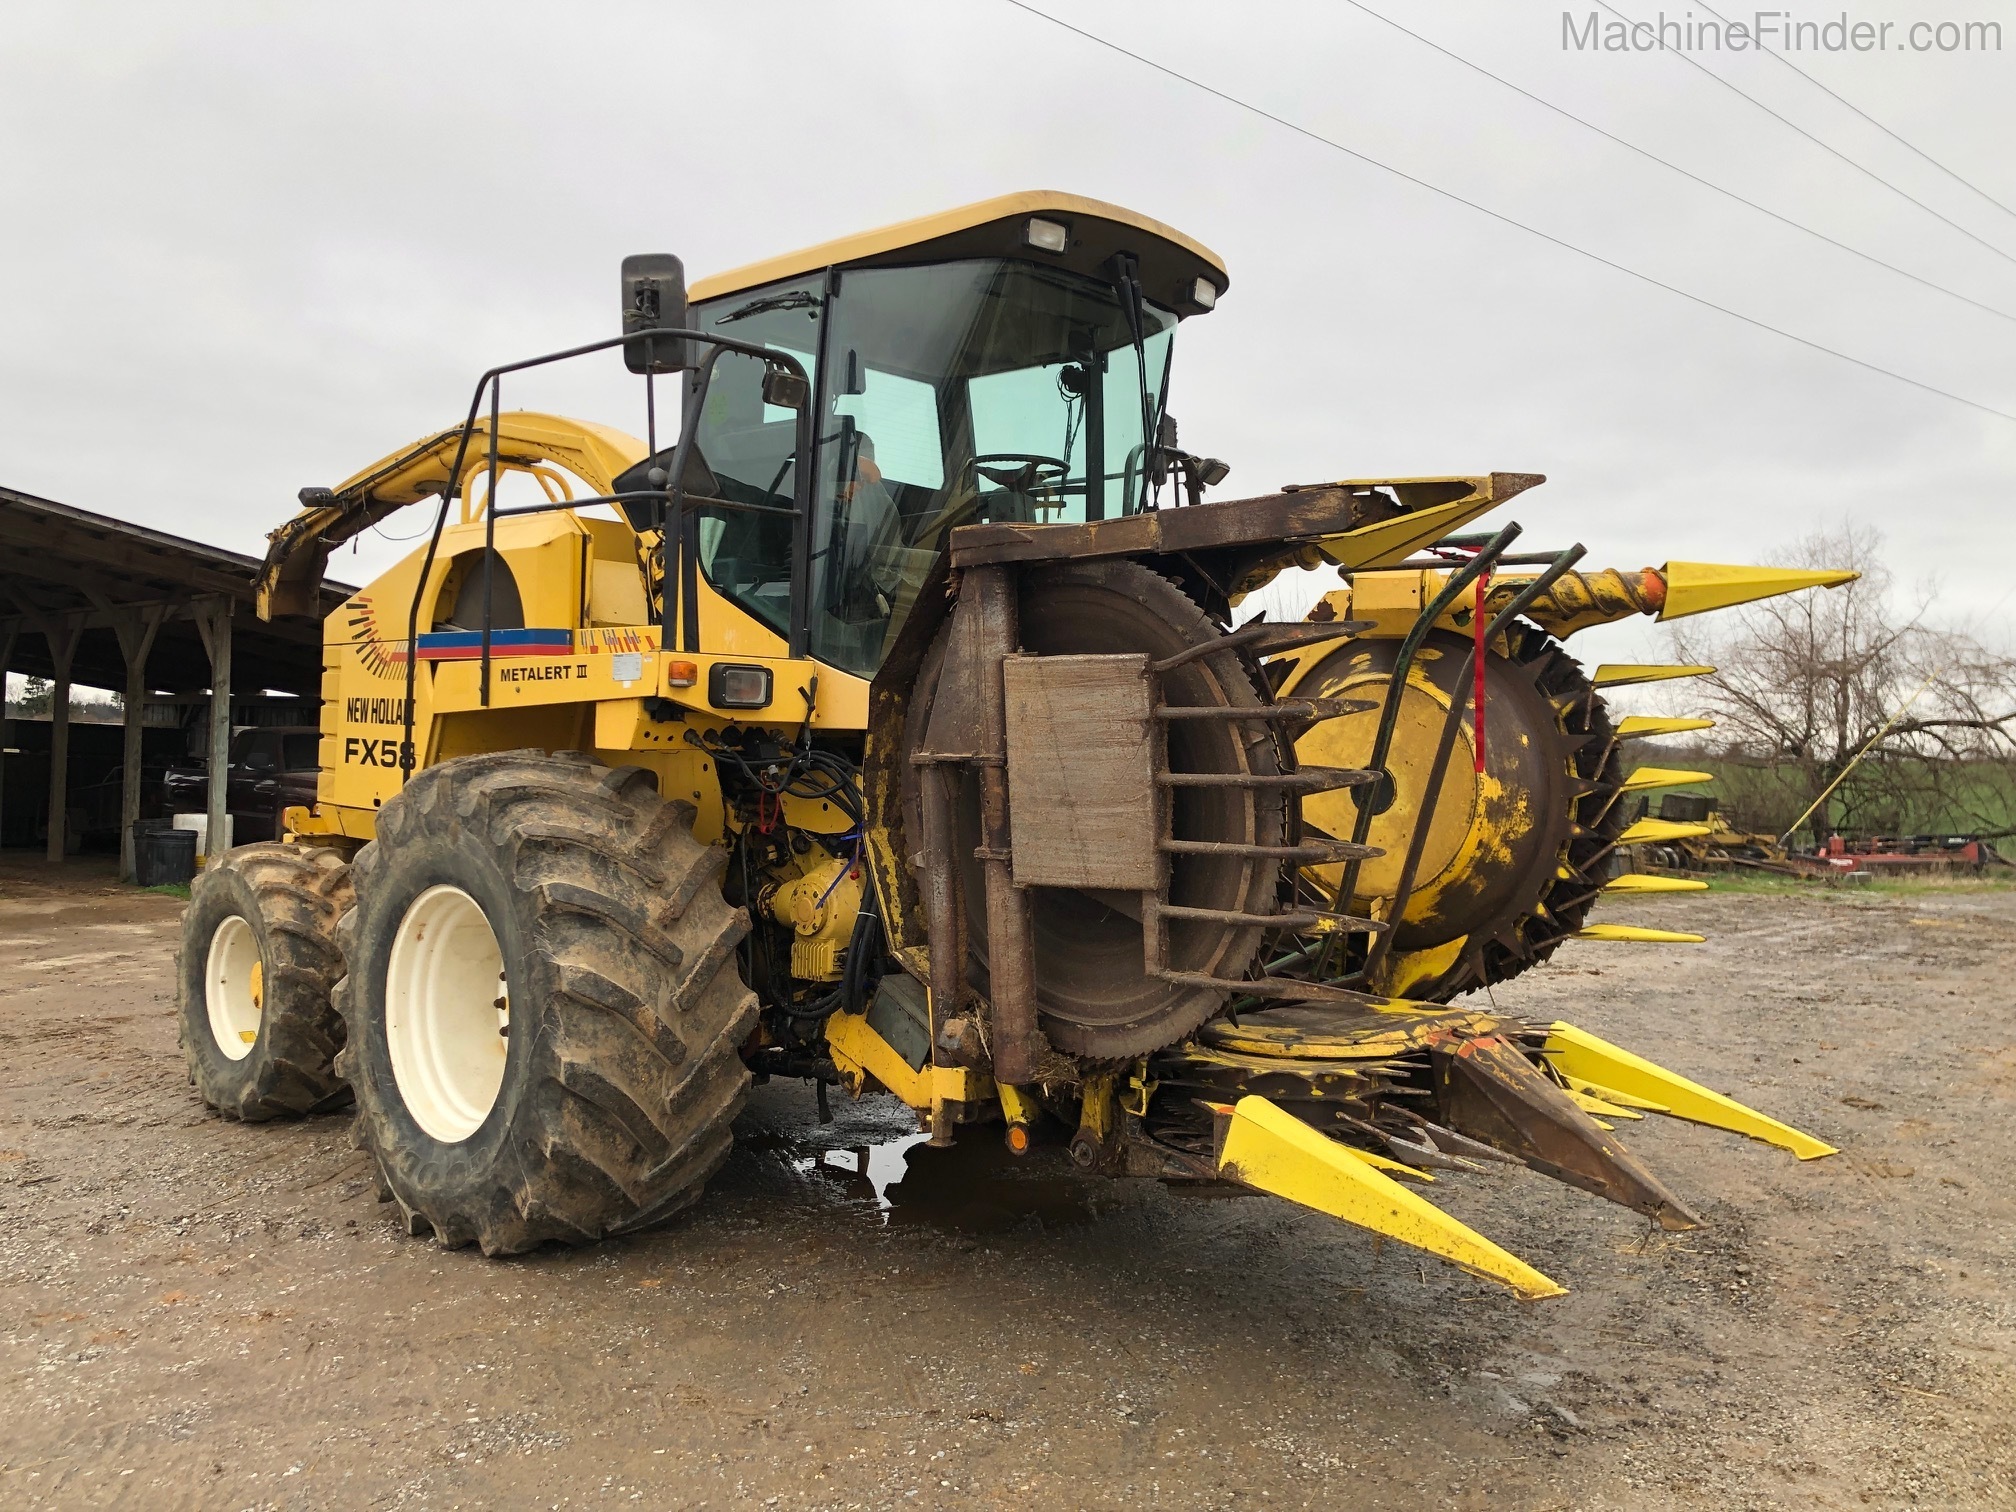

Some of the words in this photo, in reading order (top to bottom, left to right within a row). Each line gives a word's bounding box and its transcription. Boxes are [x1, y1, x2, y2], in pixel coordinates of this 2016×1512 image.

[500, 665, 571, 682] METALERT
[576, 664, 588, 679] III
[346, 697, 370, 723] NEW
[370, 698, 416, 726] HOLLA
